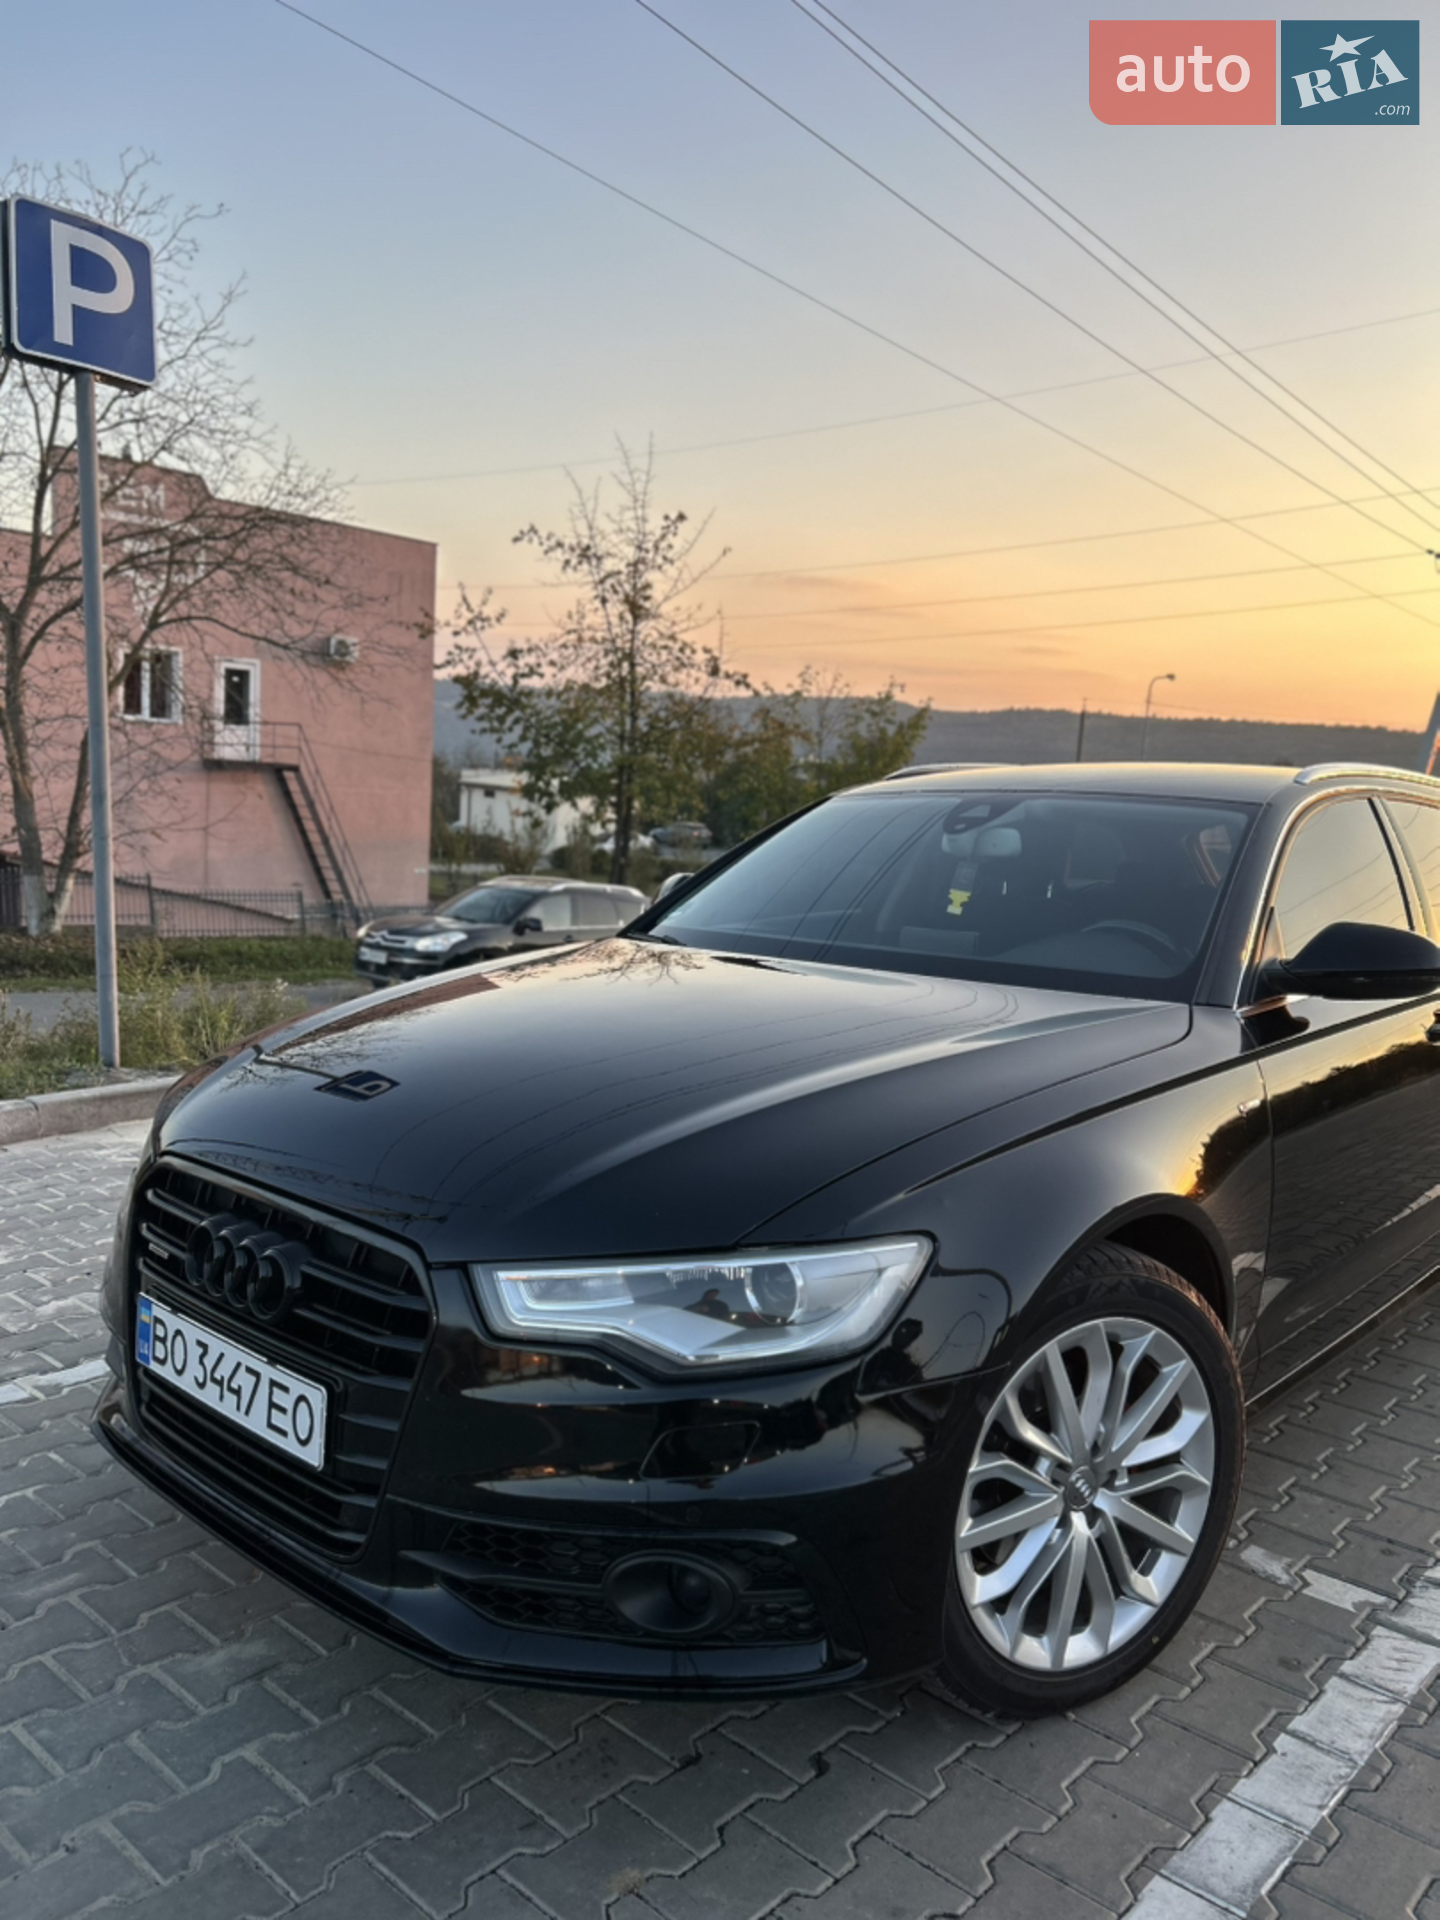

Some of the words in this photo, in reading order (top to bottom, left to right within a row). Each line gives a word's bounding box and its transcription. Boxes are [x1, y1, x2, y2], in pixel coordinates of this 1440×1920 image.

[51, 218, 135, 346] P
[152, 1315, 187, 1376] BO
[193, 1339, 261, 1416] 3447
[266, 1377, 315, 1447] EO
